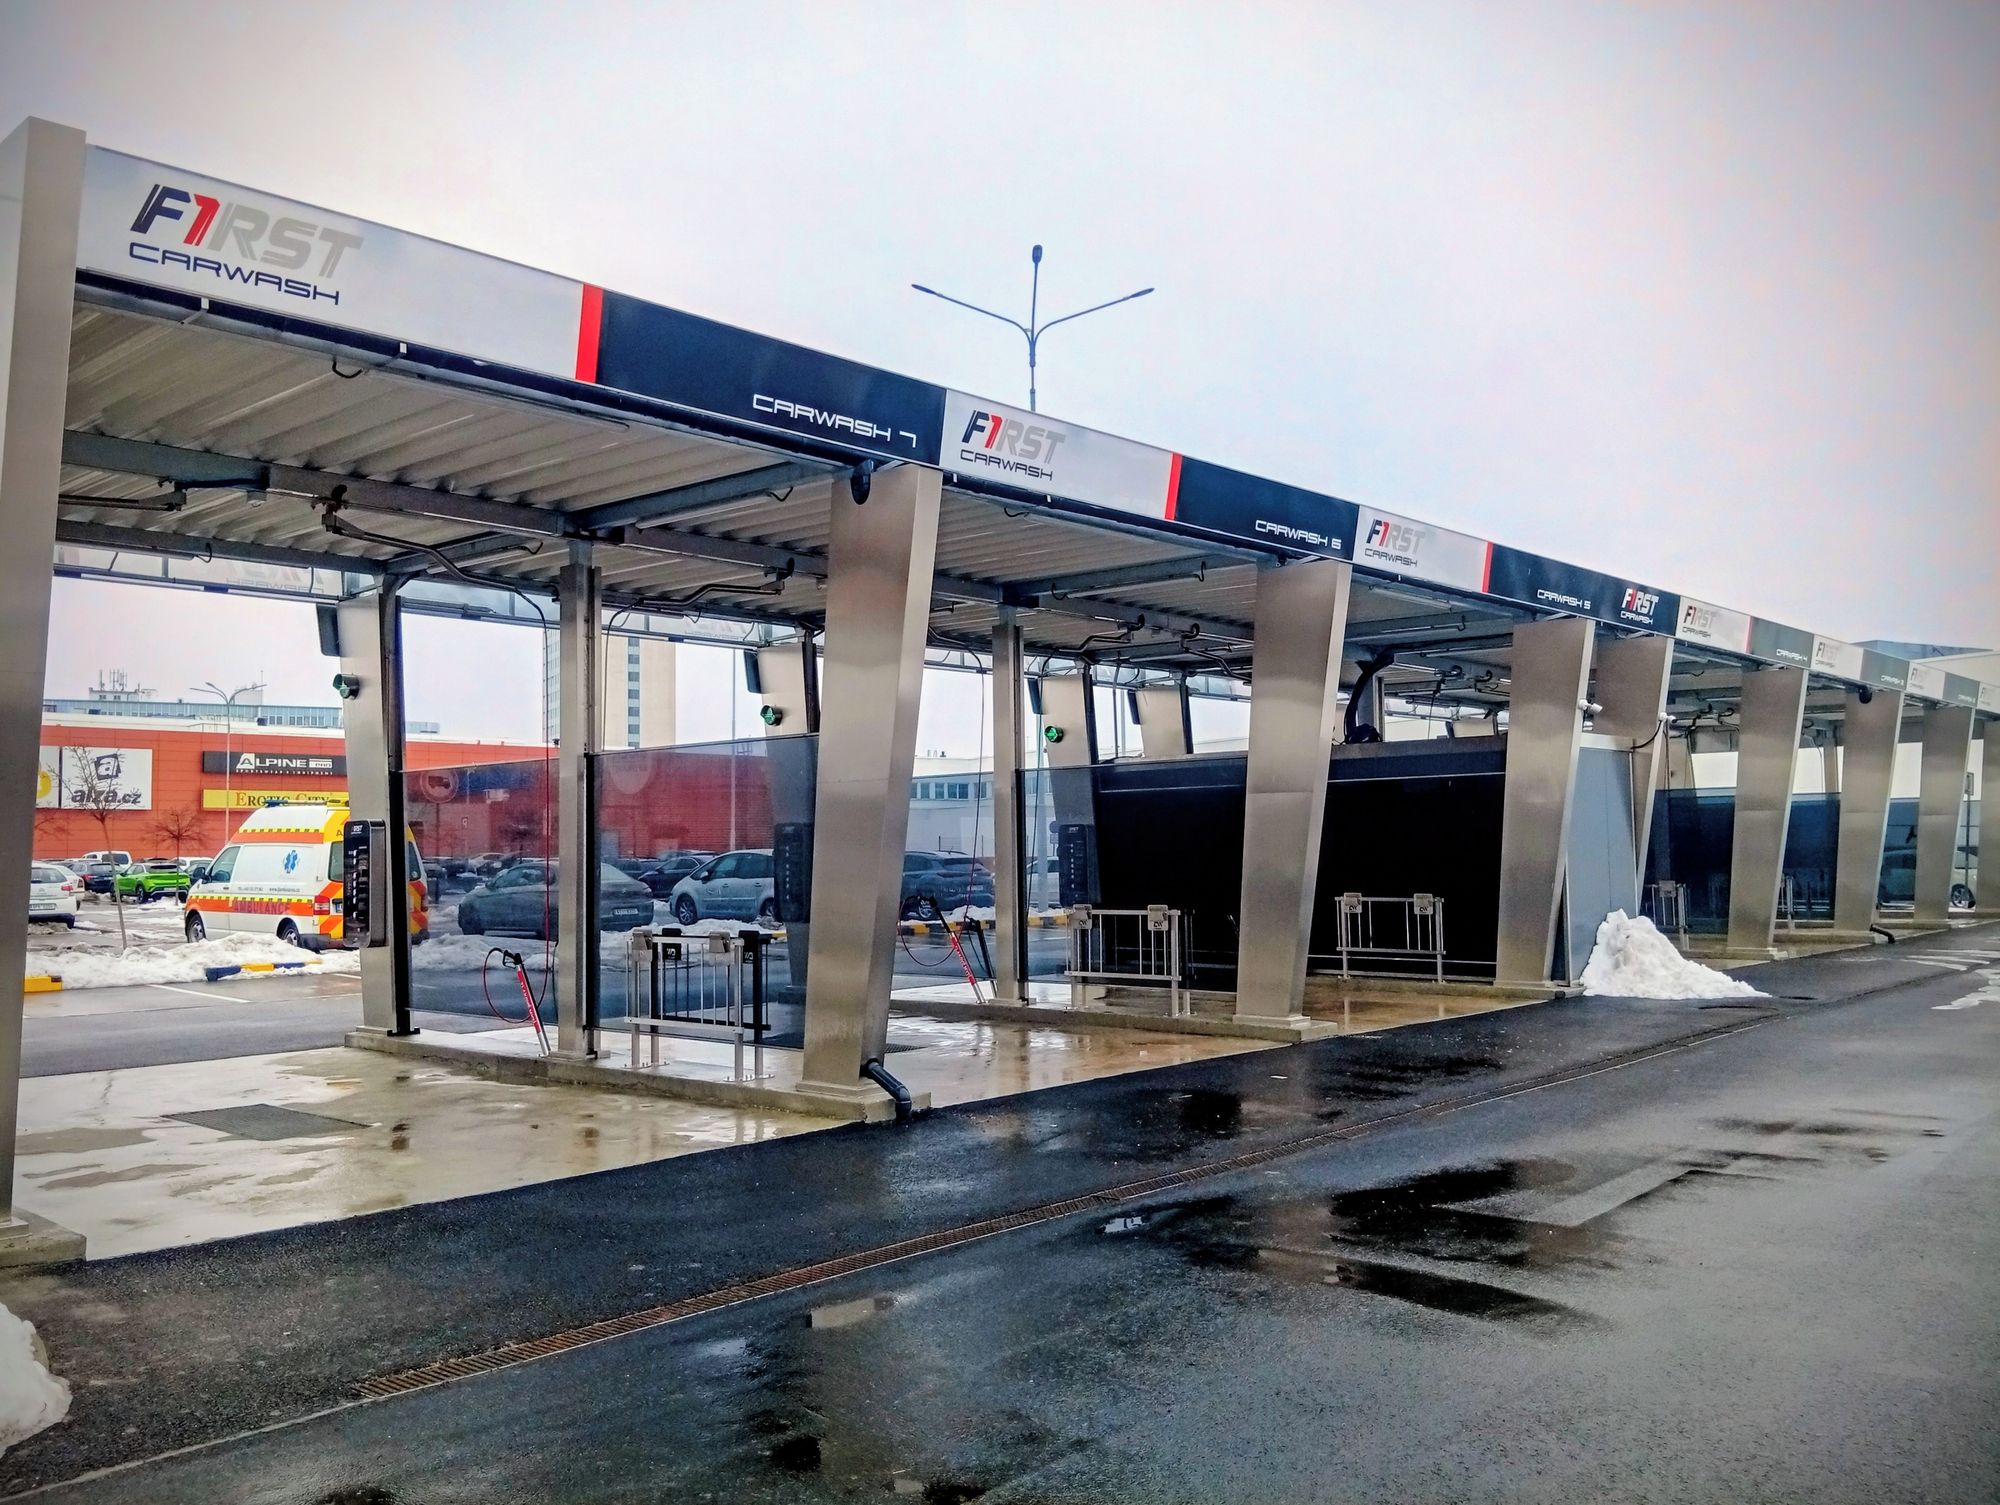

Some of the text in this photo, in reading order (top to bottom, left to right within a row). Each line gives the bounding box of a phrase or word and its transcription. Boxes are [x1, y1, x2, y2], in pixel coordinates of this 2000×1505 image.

[129, 242, 339, 305] CARWASH
[753, 394, 917, 448] CARWASH 7
[961, 449, 1053, 480] CARWASH
[1255, 520, 1342, 550] CARWASH 6
[1364, 548, 1418, 568] CARWASH
[1537, 589, 1583, 608] CARWASH
[1620, 610, 1653, 624] CARWASH
[236, 753, 307, 769] ALPINE
